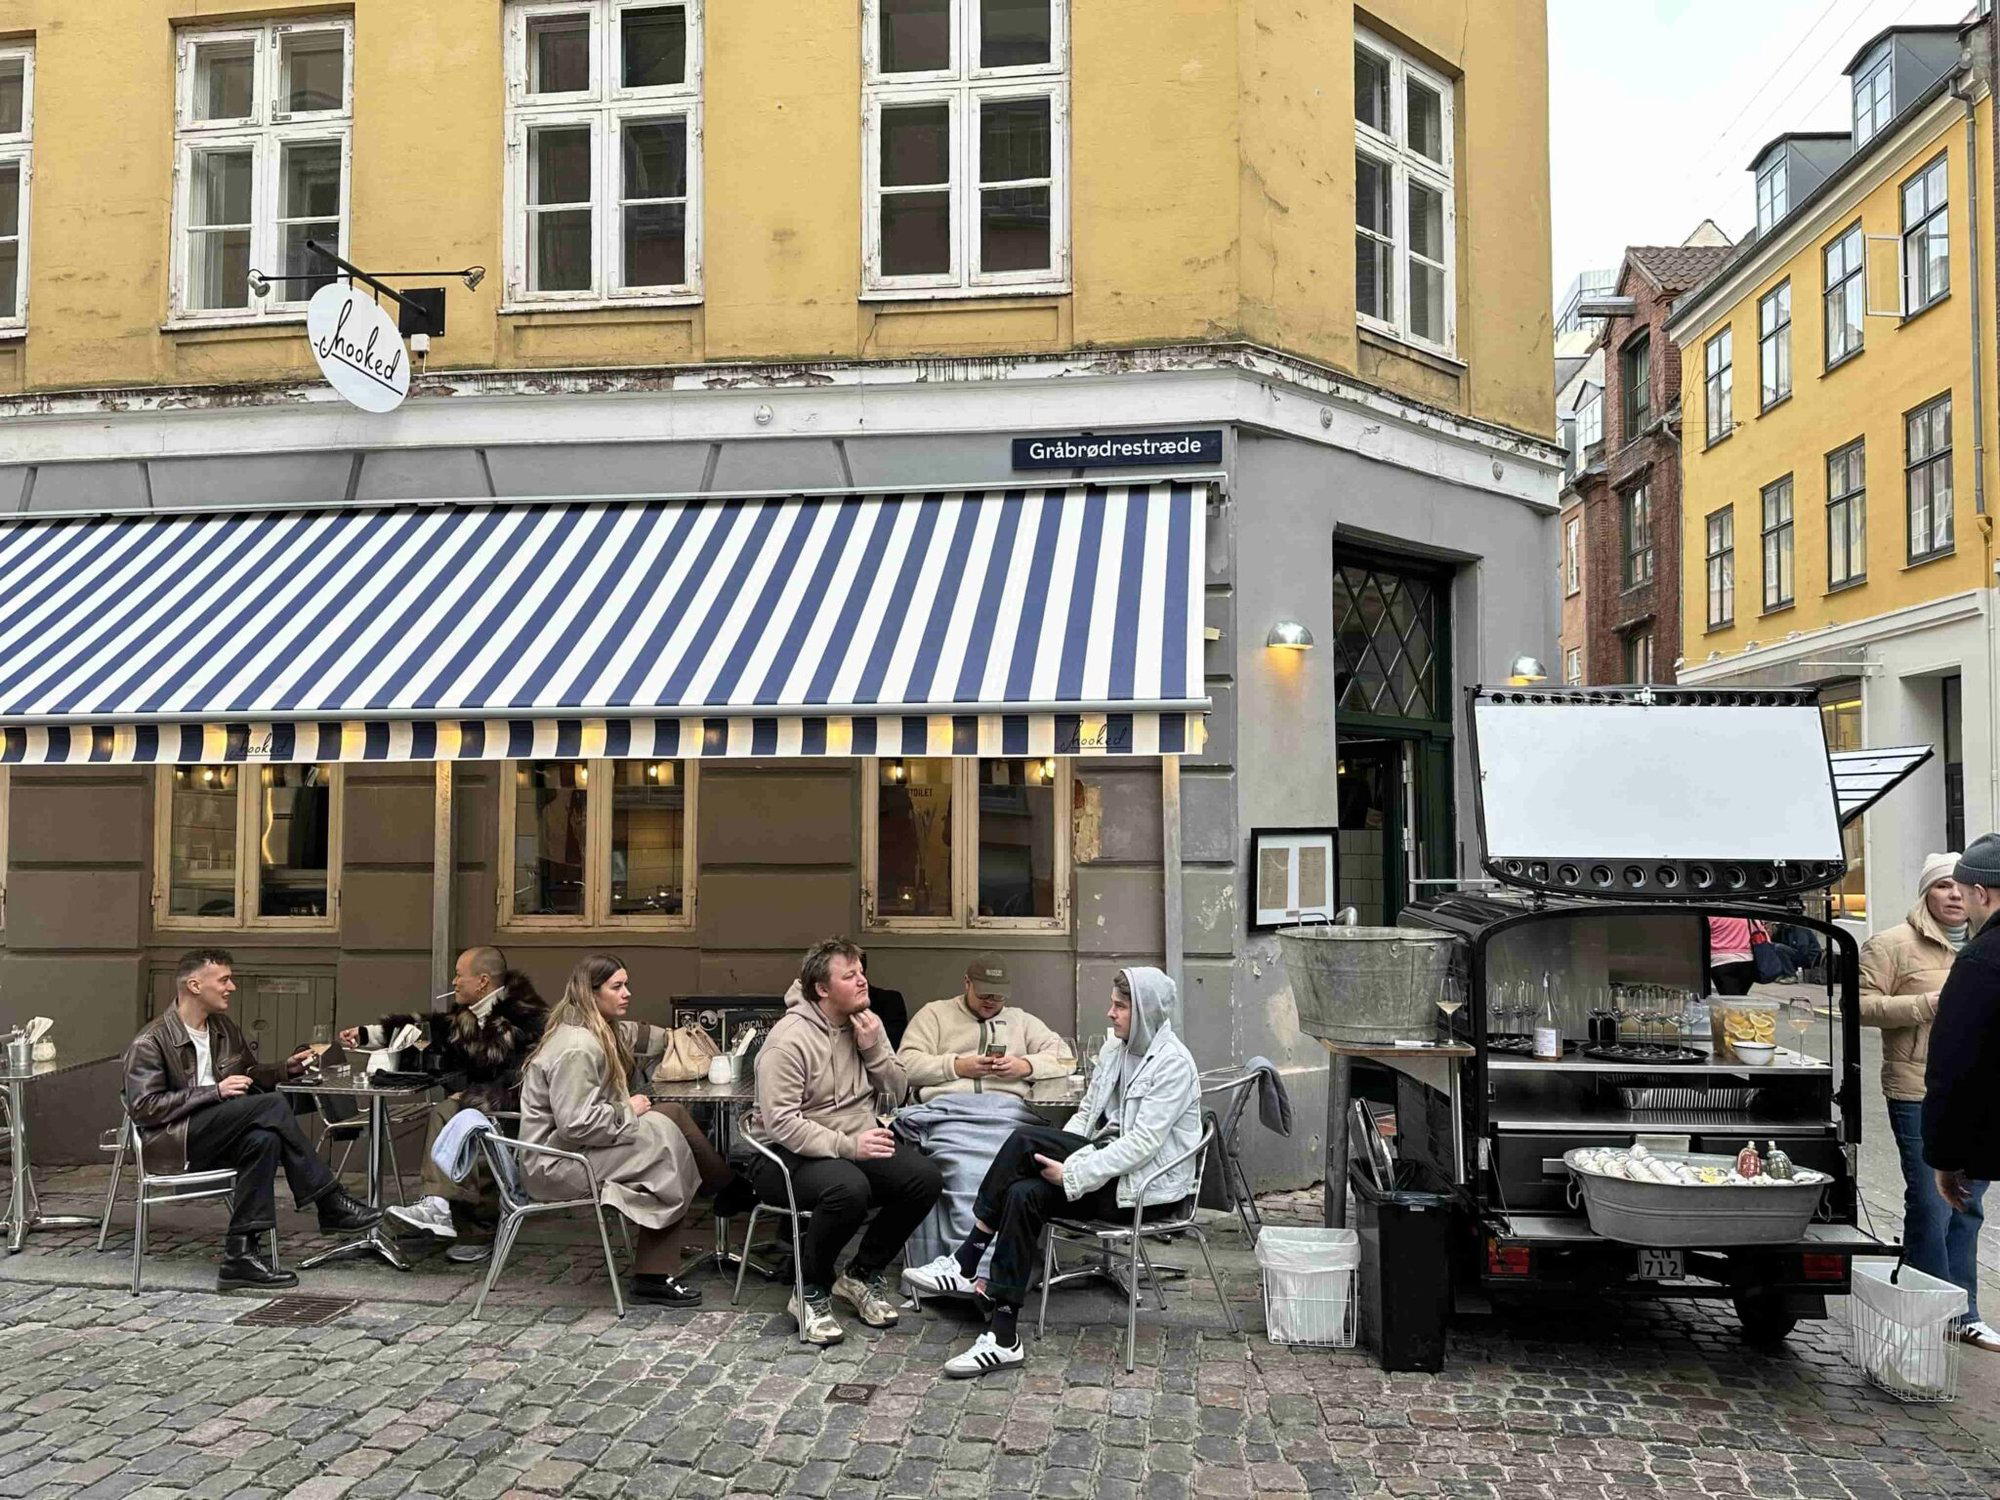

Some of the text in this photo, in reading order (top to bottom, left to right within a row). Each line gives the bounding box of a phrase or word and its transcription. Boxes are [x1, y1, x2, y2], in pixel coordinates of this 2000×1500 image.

[317, 298, 401, 383] hooked
[1029, 436, 1202, 460] Gråbrødrestræde
[1644, 1260, 1679, 1276] 712
